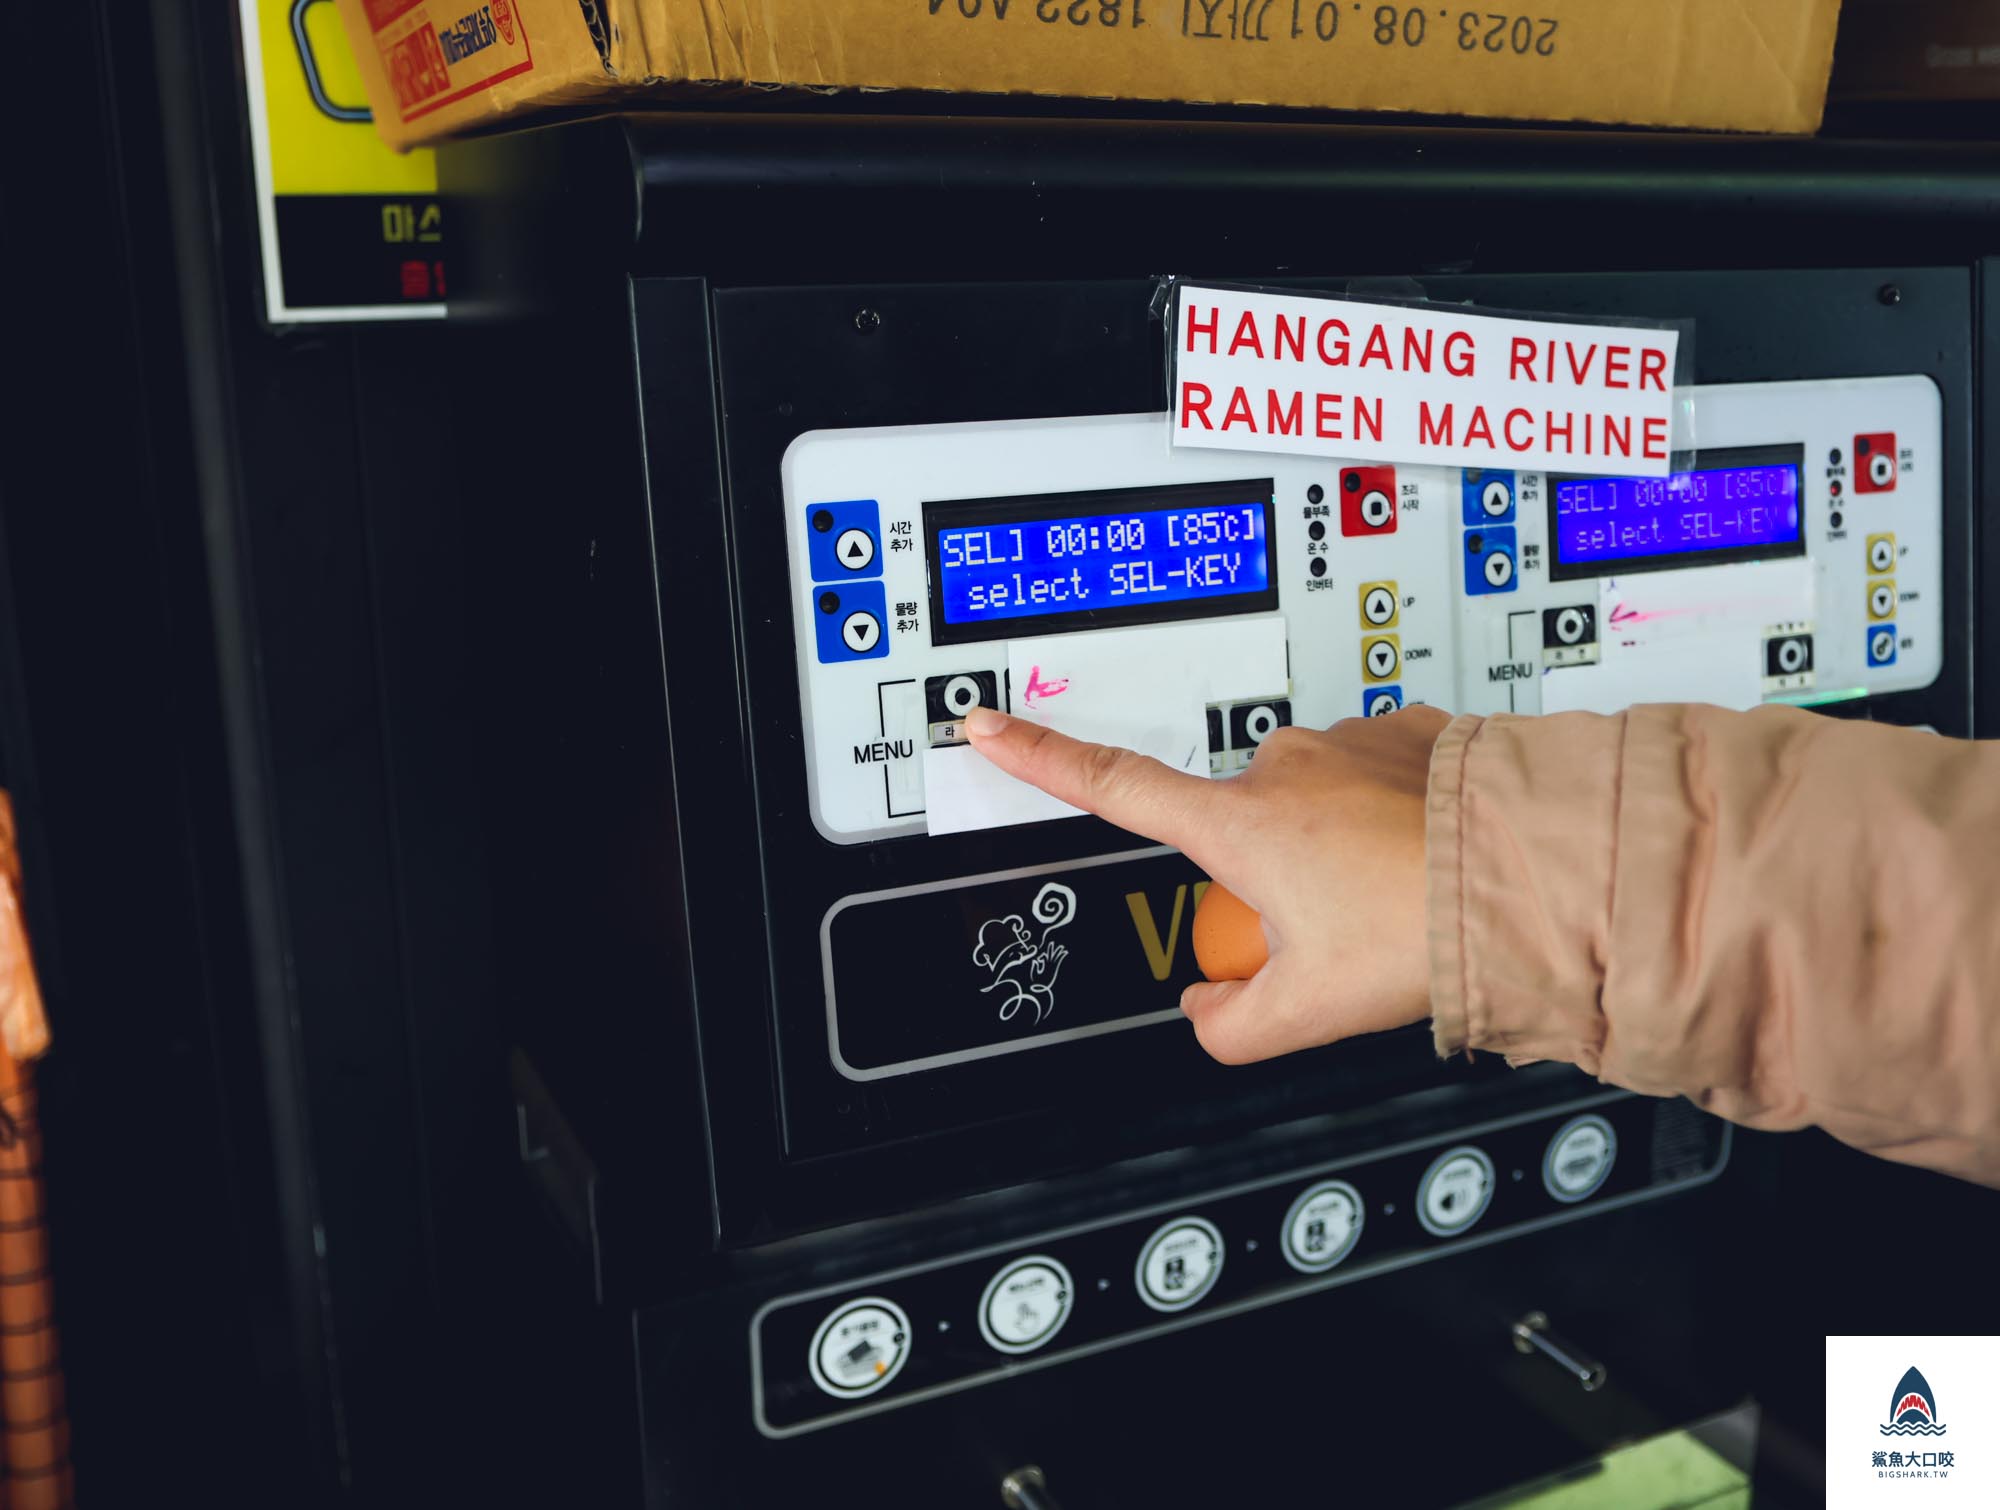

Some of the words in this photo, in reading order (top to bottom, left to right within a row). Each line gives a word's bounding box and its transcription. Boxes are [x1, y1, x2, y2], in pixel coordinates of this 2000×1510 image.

[1185, 304, 1476, 378] HANGANG
[1509, 336, 1667, 392] RIVER
[1180, 381, 1383, 442] RAMEN
[1418, 401, 1667, 460] MACHINE
[889, 520, 912, 535] 시간
[1576, 516, 1665, 551] select
[890, 538, 913, 552] 추가
[943, 528, 1023, 568] SEL]
[1047, 518, 1146, 558] 00:00
[968, 567, 1090, 611] select
[1109, 552, 1241, 596] SEL-KEY
[895, 601, 918, 616] 물량
[1402, 596, 1416, 608] UP
[896, 619, 919, 633] 추가
[1404, 647, 1432, 661] DOWN
[1487, 662, 1533, 683] MENU
[853, 739, 913, 765] MENU
